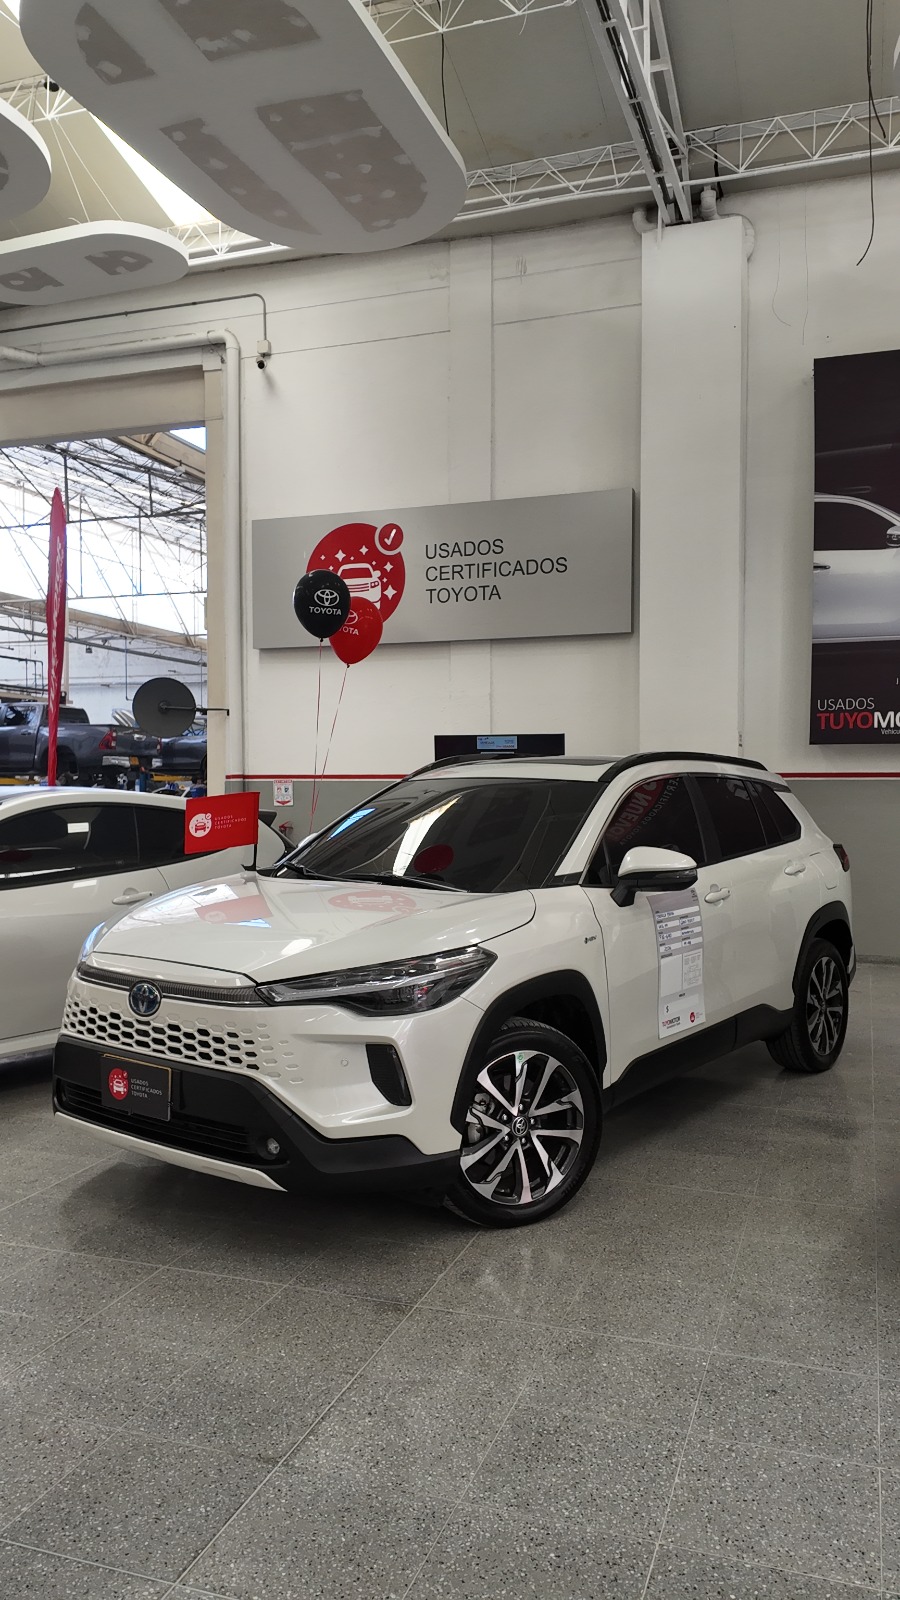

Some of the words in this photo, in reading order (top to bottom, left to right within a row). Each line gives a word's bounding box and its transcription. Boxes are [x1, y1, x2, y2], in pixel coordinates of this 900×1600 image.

[425, 538, 504, 560] USADOS
[425, 556, 568, 582] CERTIFICADOS
[425, 584, 502, 604] TOYOTA
[308, 606, 342, 616] TOYOTA
[340, 626, 359, 636] OTA
[817, 697, 875, 711] USADOS
[131, 1078, 149, 1086] USADOS
[131, 1084, 162, 1096] CERTIFICADOS
